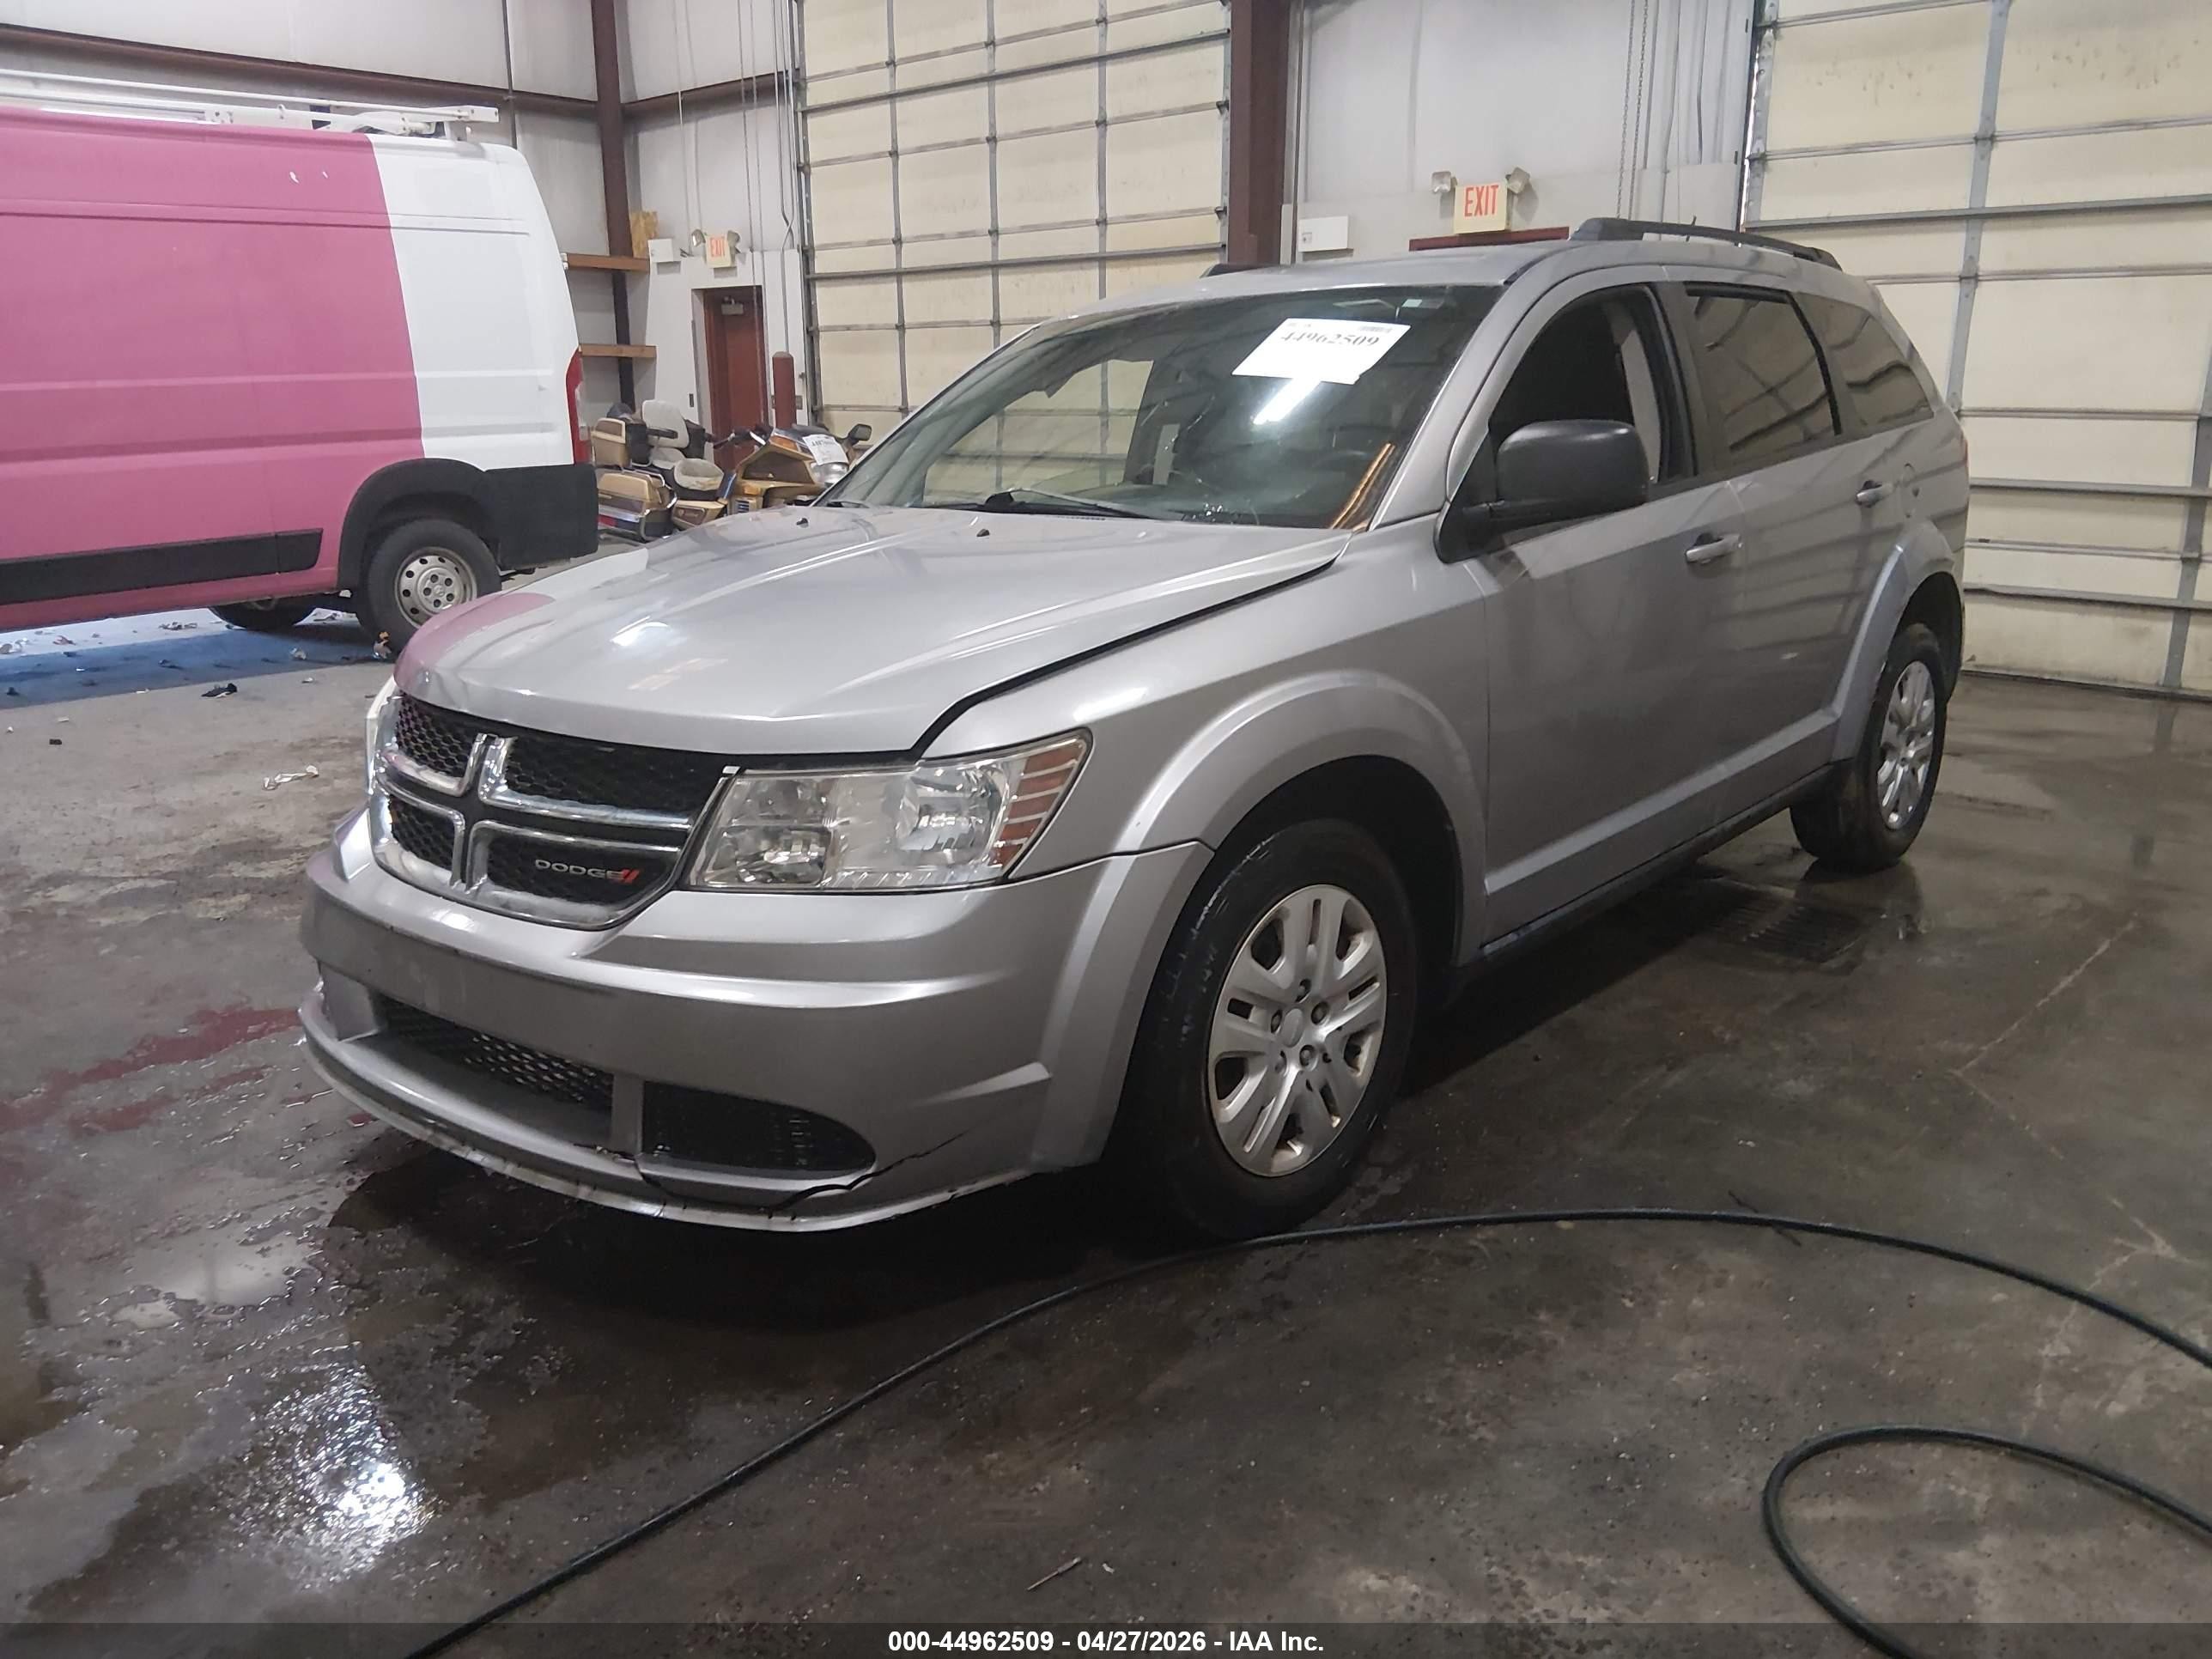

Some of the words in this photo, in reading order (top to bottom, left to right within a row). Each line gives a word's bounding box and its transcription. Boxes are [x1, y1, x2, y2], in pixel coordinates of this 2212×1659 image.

[1464, 185, 1499, 217] EXIT
[1280, 331, 1380, 346] 44962509
[535, 859, 625, 881] DODGE
